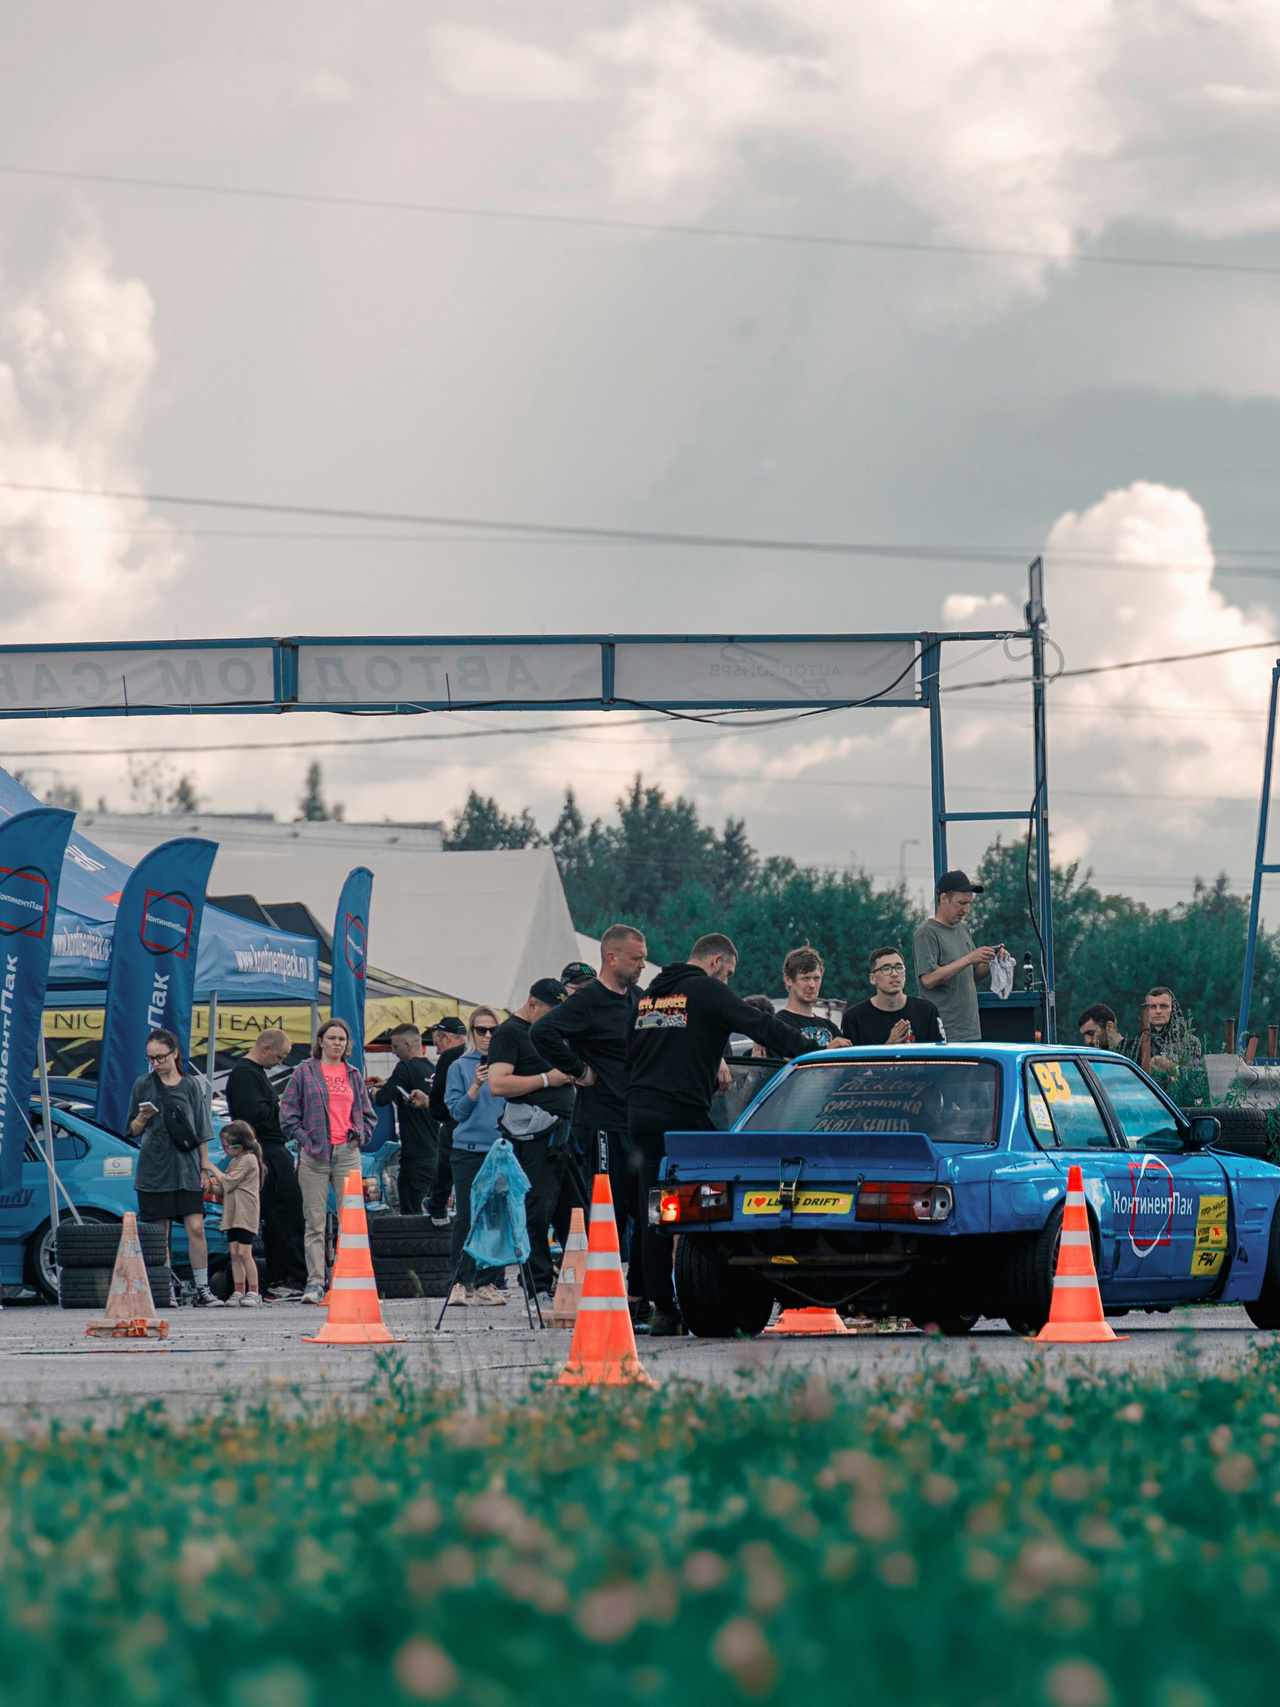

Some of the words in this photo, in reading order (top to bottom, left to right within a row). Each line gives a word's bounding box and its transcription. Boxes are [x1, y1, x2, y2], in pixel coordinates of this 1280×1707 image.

[0, 891, 44, 912] онтинентПак
[1034, 1061, 1072, 1104] 93
[802, 1197, 840, 1207] DRIFT
[1113, 1190, 1193, 1216] КонтинентПак
